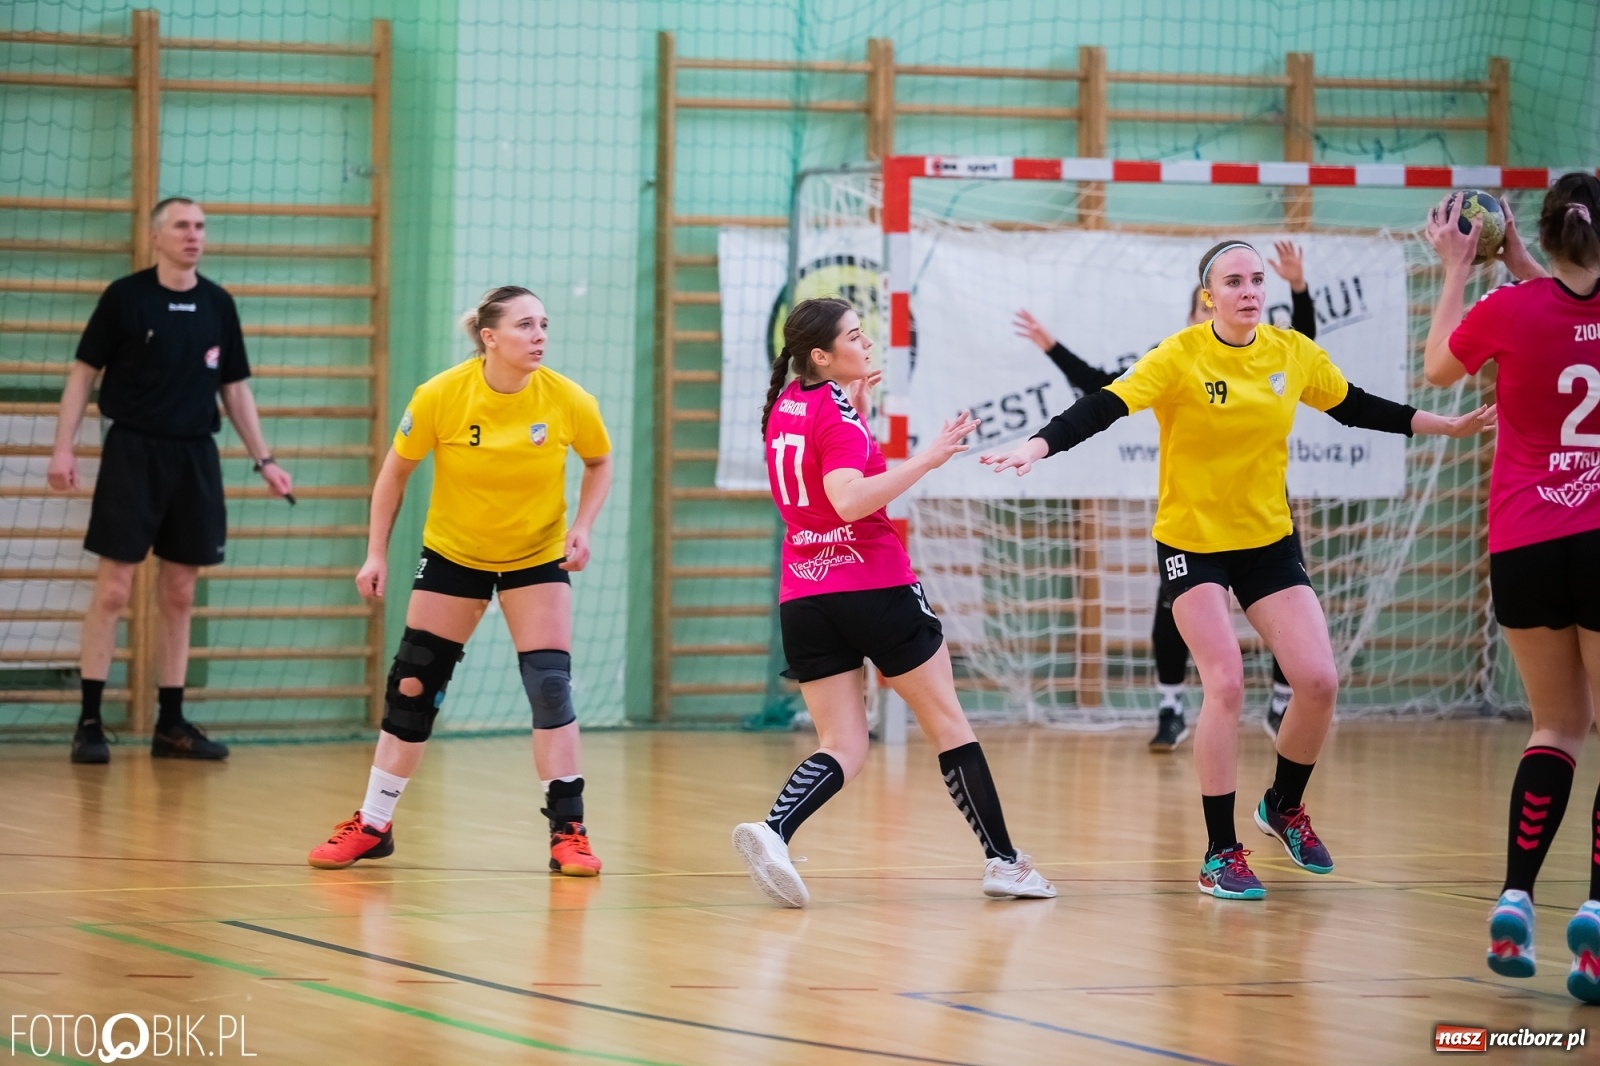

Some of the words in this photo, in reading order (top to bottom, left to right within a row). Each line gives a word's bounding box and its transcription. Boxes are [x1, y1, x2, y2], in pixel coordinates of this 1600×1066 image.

[1204, 380, 1228, 404] 99
[469, 424, 481, 447] 3
[771, 431, 810, 507] 17
[792, 553, 856, 572] TechControl
[1165, 553, 1189, 581] 99
